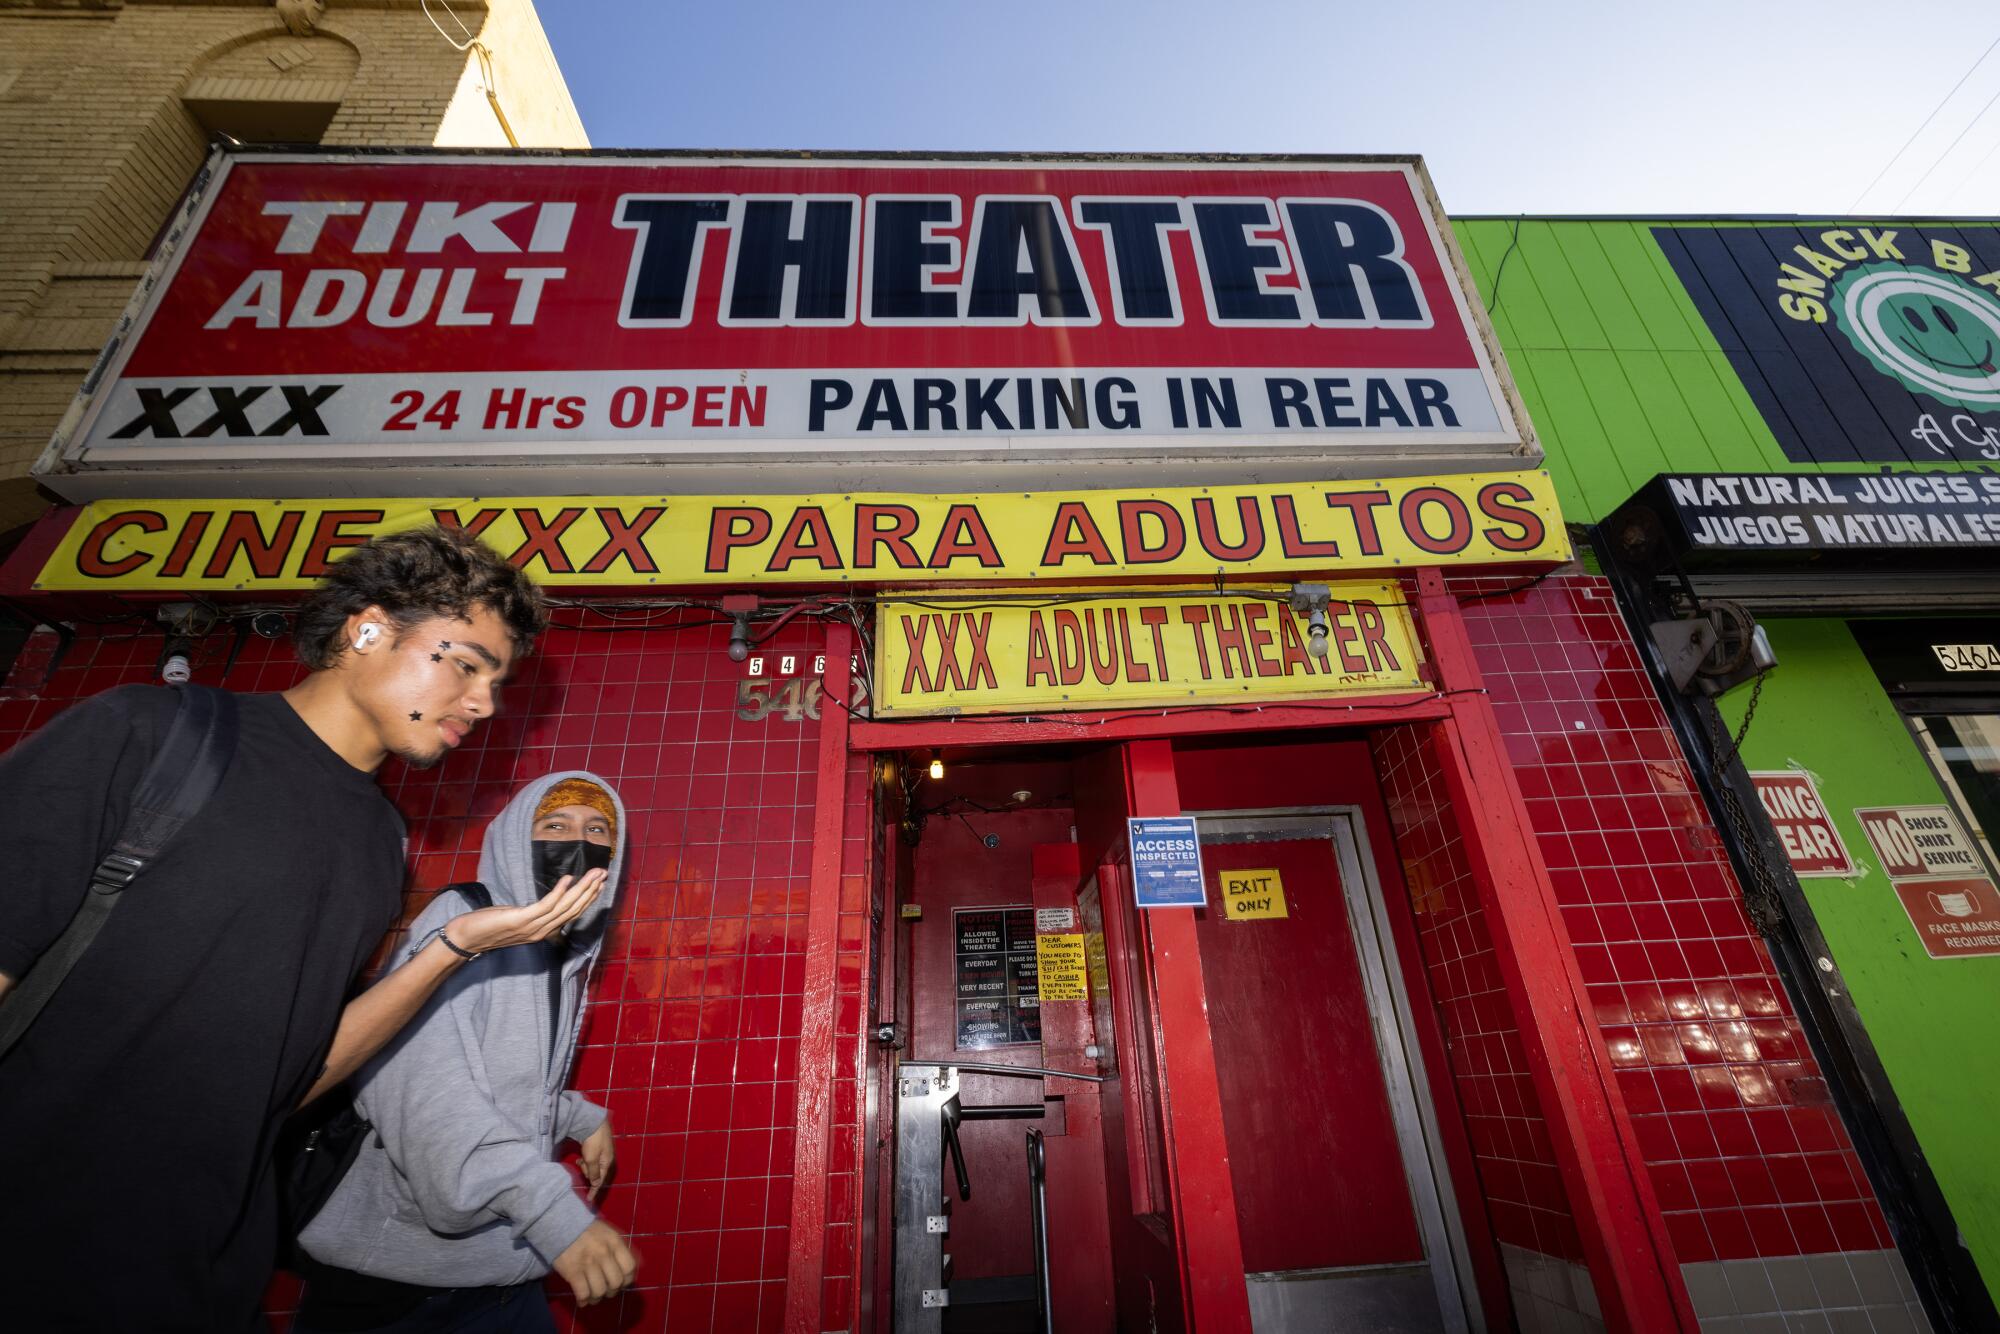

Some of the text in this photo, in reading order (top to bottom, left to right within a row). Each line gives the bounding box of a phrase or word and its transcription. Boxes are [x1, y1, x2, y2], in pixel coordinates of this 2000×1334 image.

[261, 202, 577, 253] TIKI
[612, 193, 1434, 329] THEATER
[1777, 228, 1905, 324] SNACK
[204, 267, 566, 330] ADULT
[108, 378, 1463, 439] XXX 24 Hrs OPEN PARKING IN REAR
[1911, 414, 1954, 455] A
[1667, 477, 1848, 506] NATURAL
[75, 509, 385, 579] CINE
[704, 502, 1005, 573] PARA
[1041, 482, 1547, 566] ADULTOS
[1693, 514, 2000, 544] JUGOS NATURALES
[901, 599, 1401, 694] XXX ADULT THEATER
[1936, 646, 2000, 670] 5464
[1905, 816, 1948, 831] SHOES
[1136, 840, 1195, 852] ACCESS
[1866, 818, 1919, 868] NO
[1914, 833, 1955, 848] SHIRT
[1136, 852, 1196, 861] INSPECTED
[1923, 850, 1973, 866] SERVICE
[1229, 877, 1272, 895] EXIT
[1237, 897, 1271, 913] ONLY
[1928, 920, 2000, 935] FACE MASKS
[965, 960, 997, 968] EVERYDAY
[960, 983, 1004, 992] VERY RECENT
[966, 1002, 999, 1010] EVERYDAY
